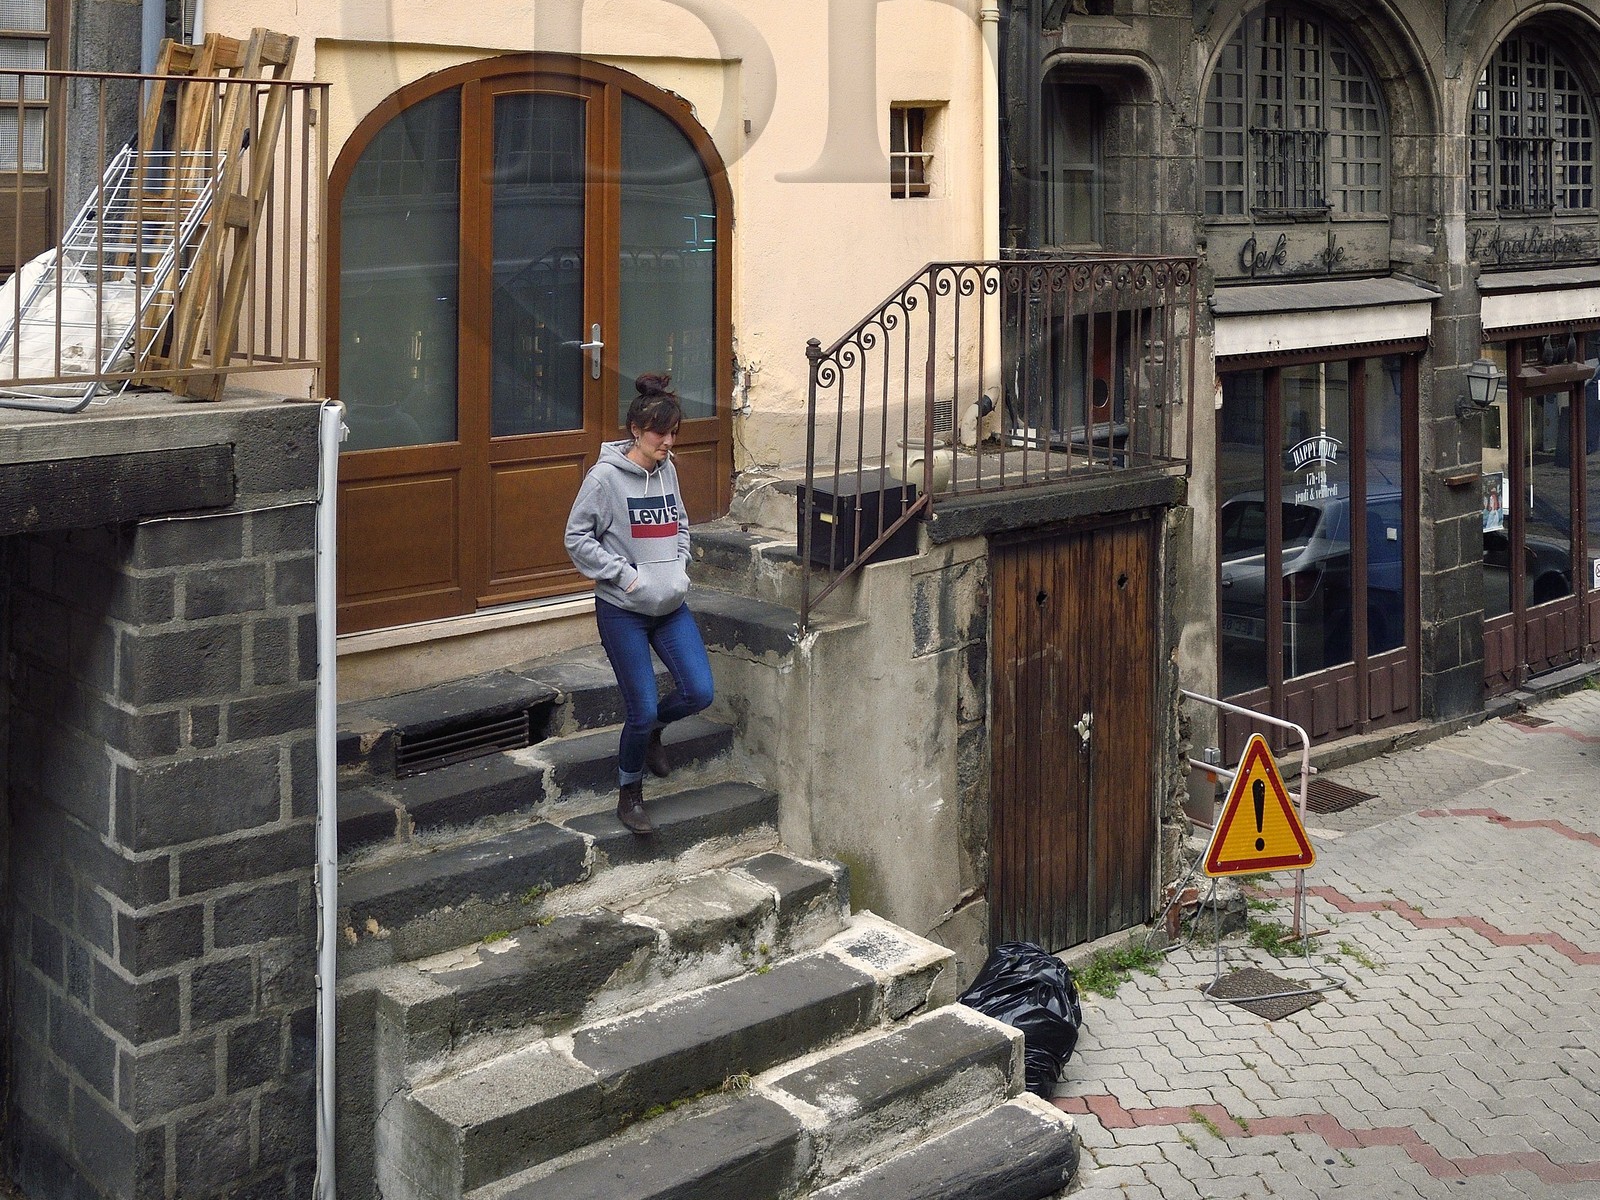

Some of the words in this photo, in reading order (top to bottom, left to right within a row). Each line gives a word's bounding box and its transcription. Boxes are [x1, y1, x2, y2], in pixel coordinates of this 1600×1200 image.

[1240, 232, 1287, 274] Café
[1322, 232, 1346, 266] de
[1292, 441, 1318, 467] HAPPY
[1295, 489, 1309, 506] jeudi
[1310, 487, 1315, 501] &
